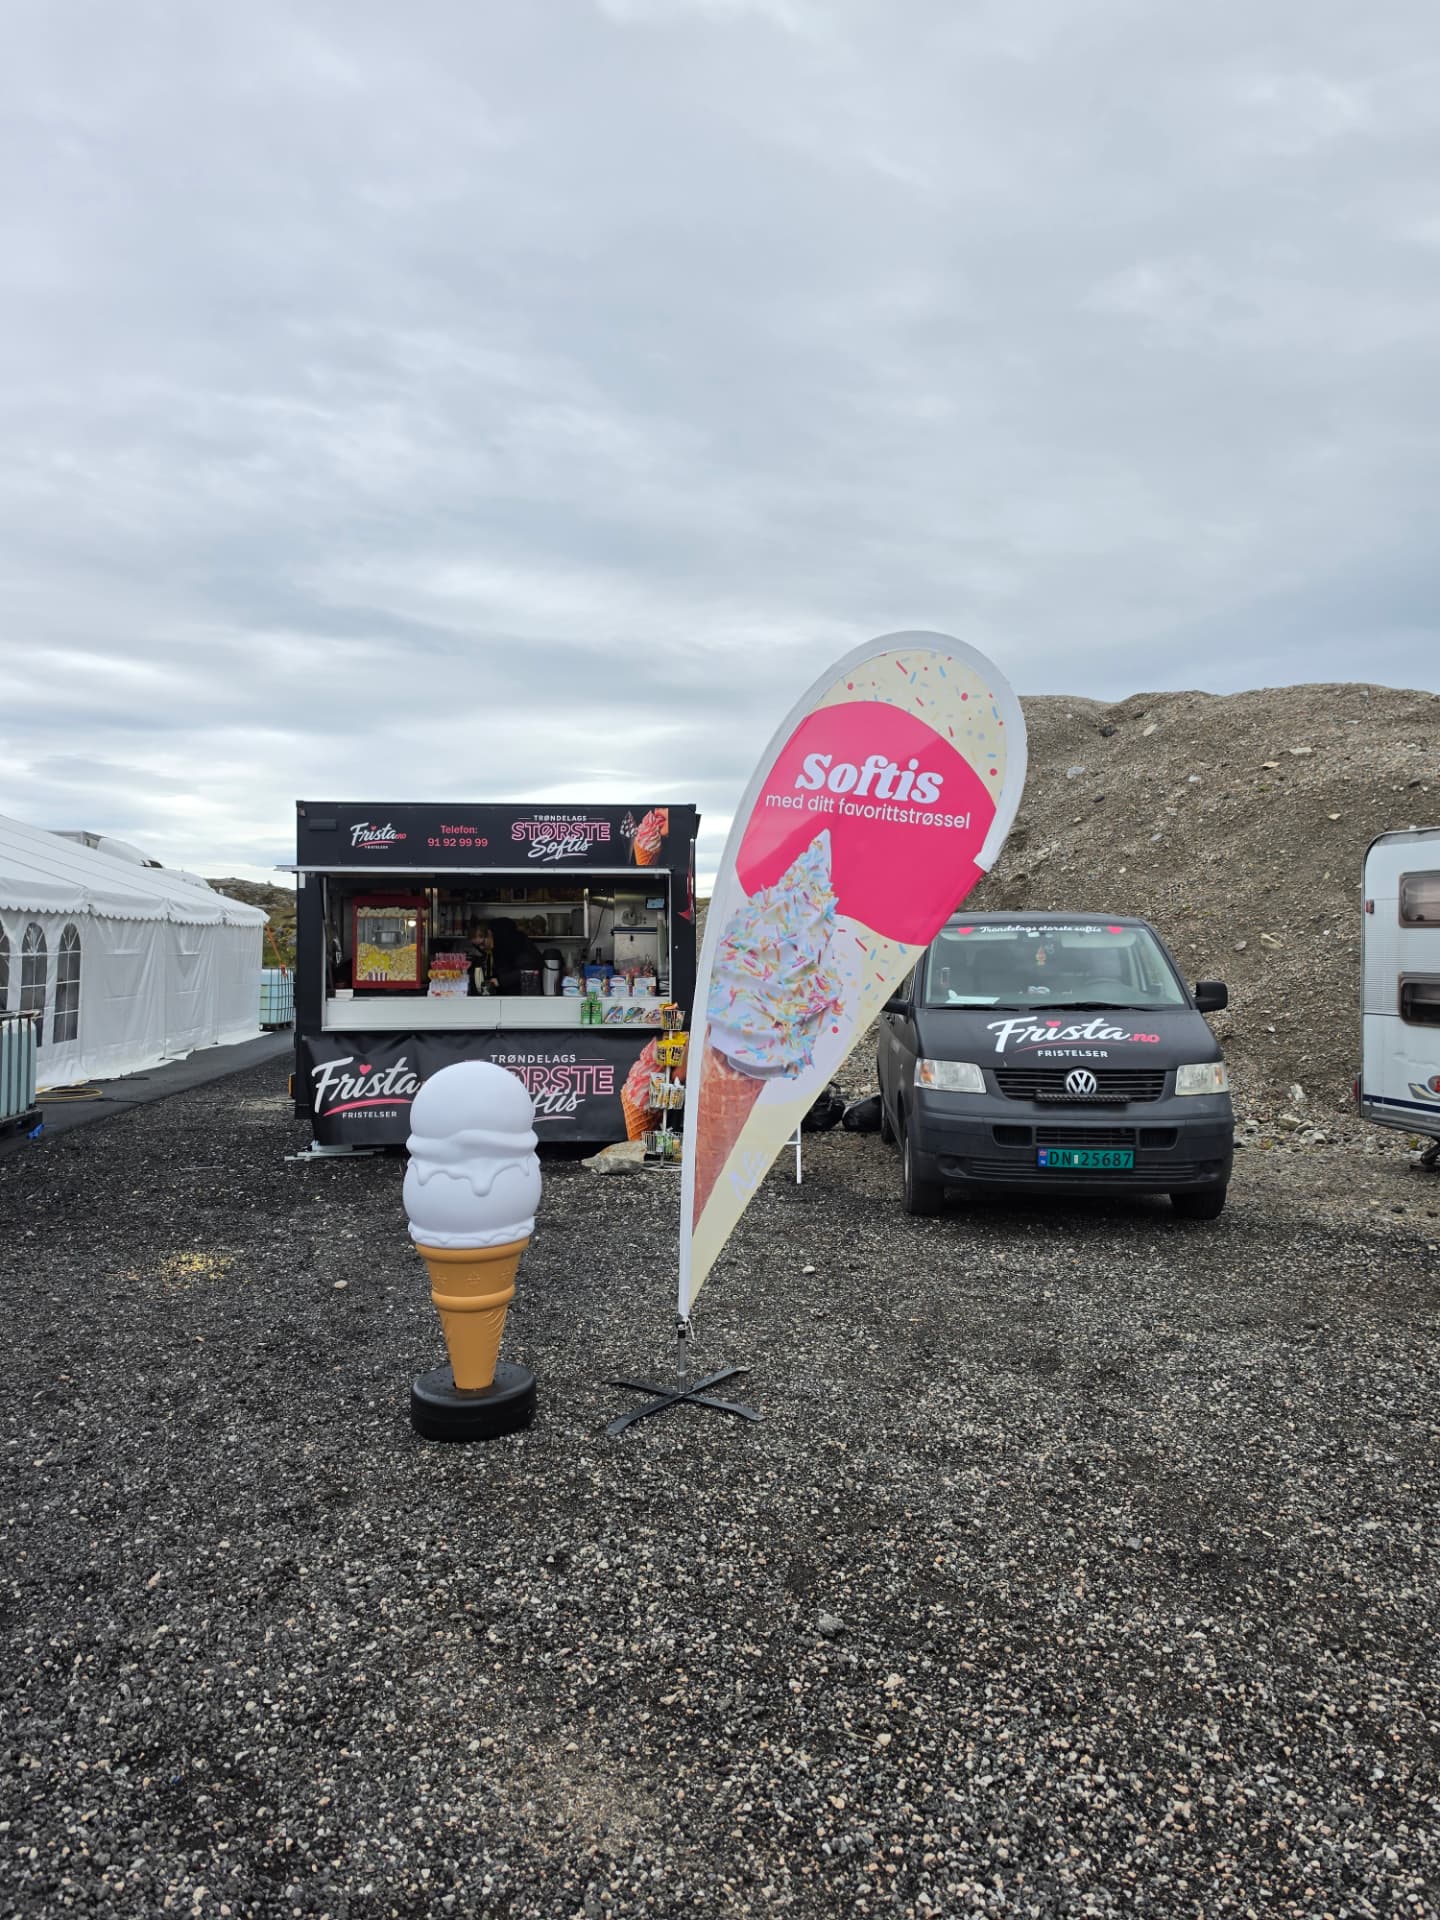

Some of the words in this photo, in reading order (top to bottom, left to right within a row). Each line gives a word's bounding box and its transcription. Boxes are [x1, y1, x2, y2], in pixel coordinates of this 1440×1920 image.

[795, 752, 944, 804] Softis
[765, 794, 804, 809] med
[807, 795, 834, 813] ditt
[838, 798, 971, 829] favorittstrøssel
[440, 825, 478, 834] Telefon:
[511, 822, 611, 841] STØRSTE
[427, 838, 441, 847] 91
[443, 838, 457, 847] 92
[459, 838, 472, 847] 99
[474, 838, 488, 847] 99
[527, 835, 593, 860] Softis
[986, 1016, 1161, 1053] Frista.no
[490, 1054, 576, 1063] TRØNDELAGS
[1037, 1049, 1109, 1058] FRISTELSER
[311, 1056, 421, 1113] Frista
[342, 1111, 397, 1119] FRISTELSER
[1049, 1151, 1072, 1166] DN
[1081, 1152, 1132, 1167] 25687
